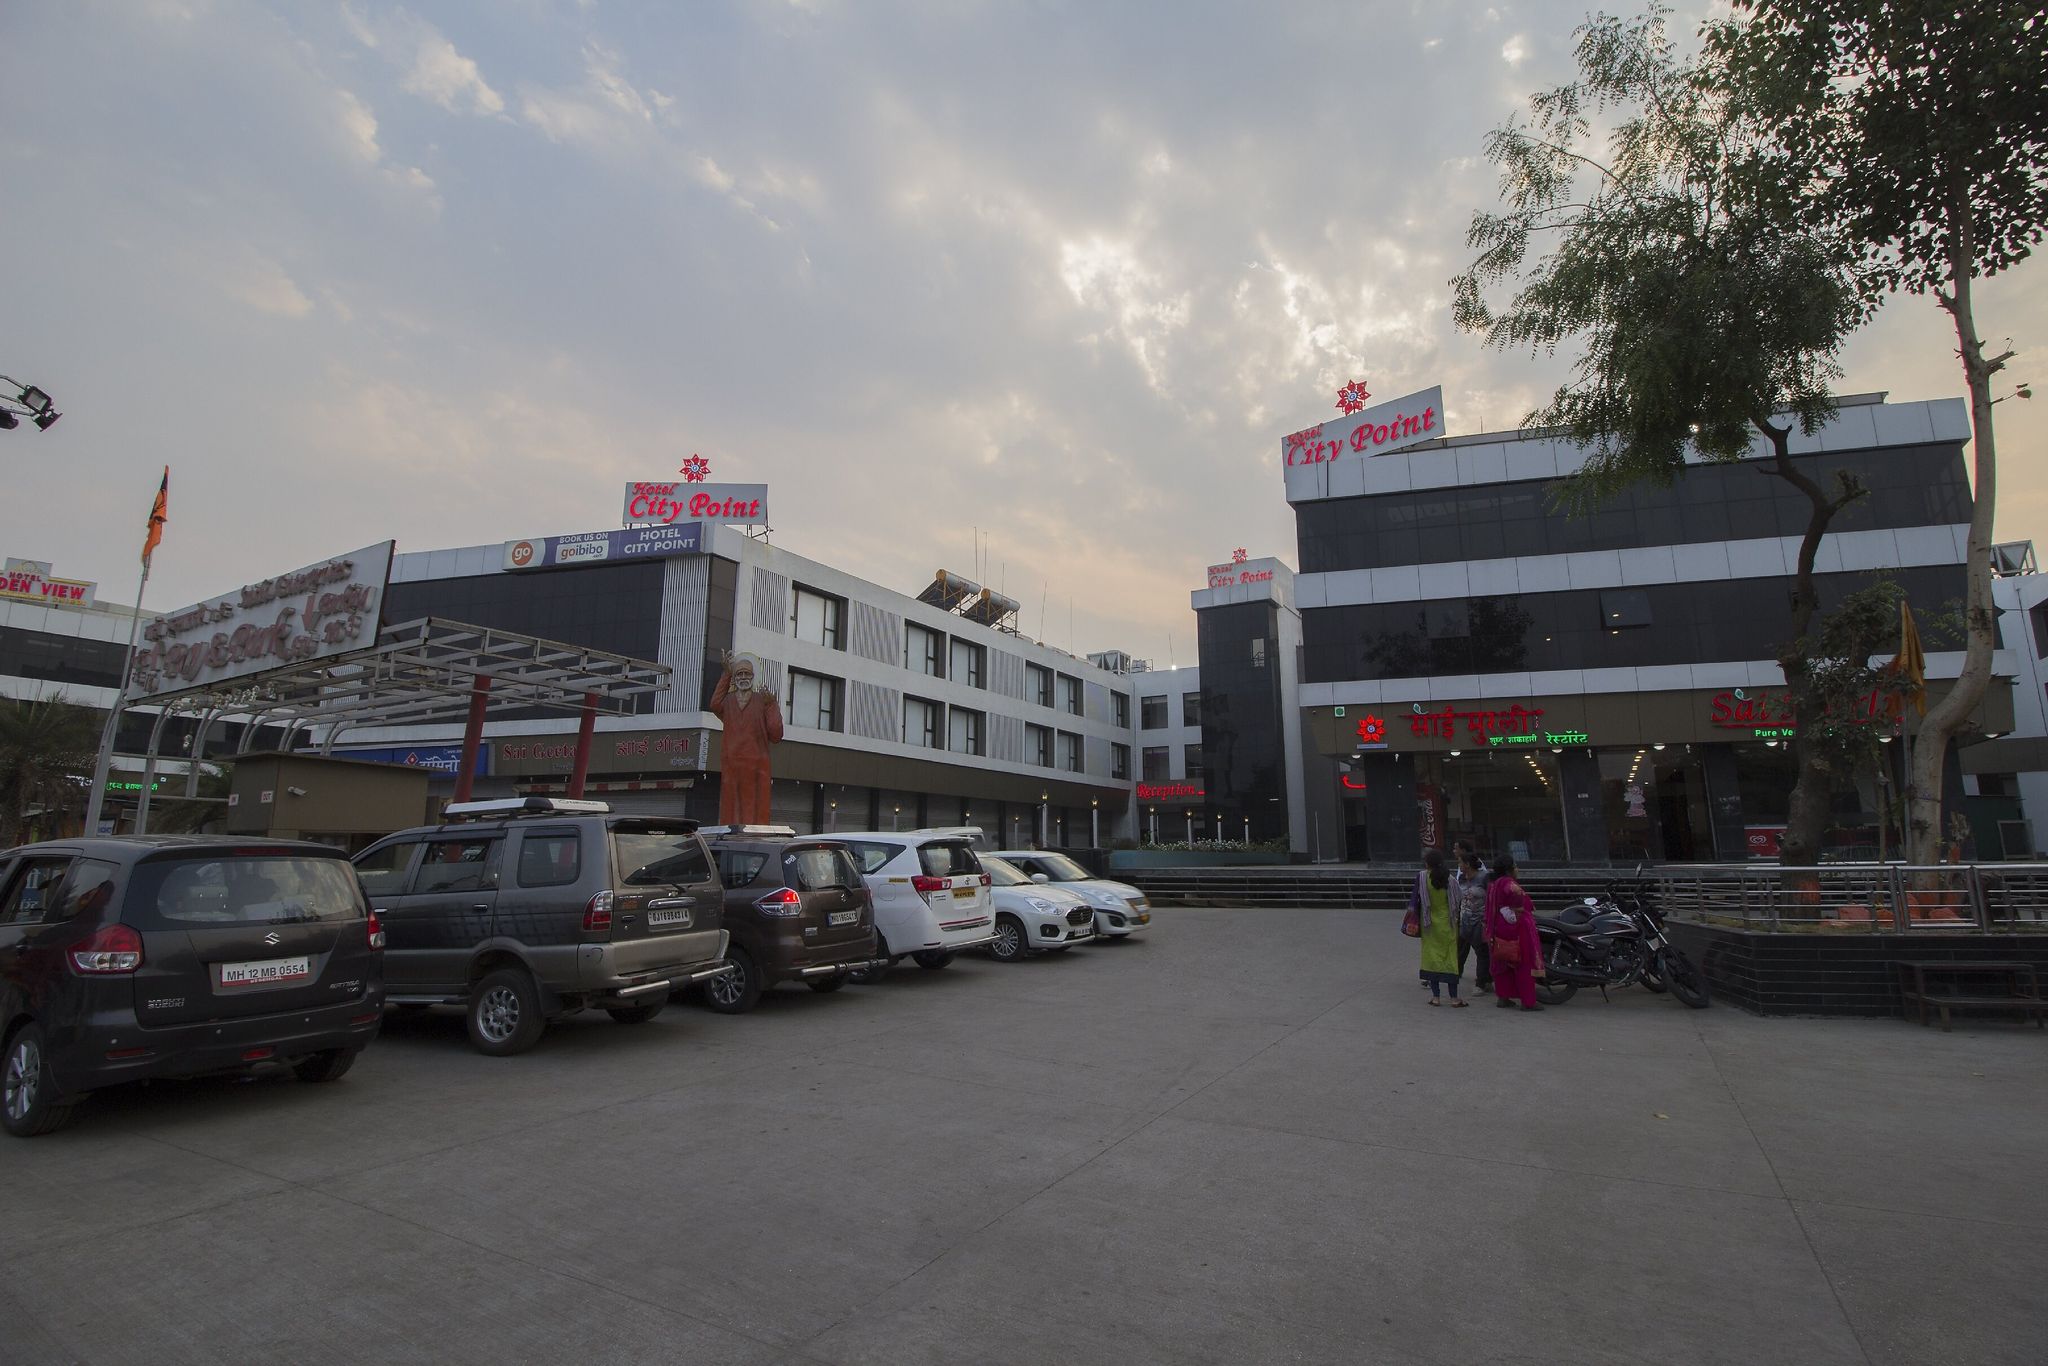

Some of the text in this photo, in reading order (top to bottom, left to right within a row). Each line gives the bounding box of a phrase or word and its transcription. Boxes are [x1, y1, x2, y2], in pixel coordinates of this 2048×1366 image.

[1287, 406, 1437, 466] City Point
[632, 482, 678, 496] Hotel
[629, 492, 760, 524] City Point
[559, 532, 609, 544] BOOK US ON
[639, 528, 681, 541] HOTEL
[514, 546, 531, 561] go
[560, 543, 604, 561] goibibo
[623, 538, 696, 555] CITY POINT
[9, 571, 42, 582] HOTEL
[1240, 568, 1273, 584] Point
[41, 582, 86, 600] VIEW
[1755, 729, 1796, 737] Pure Ve
[503, 743, 528, 760] Sai
[1136, 783, 1195, 801] Reception
[227, 964, 305, 981] MH 12 MB 0554
